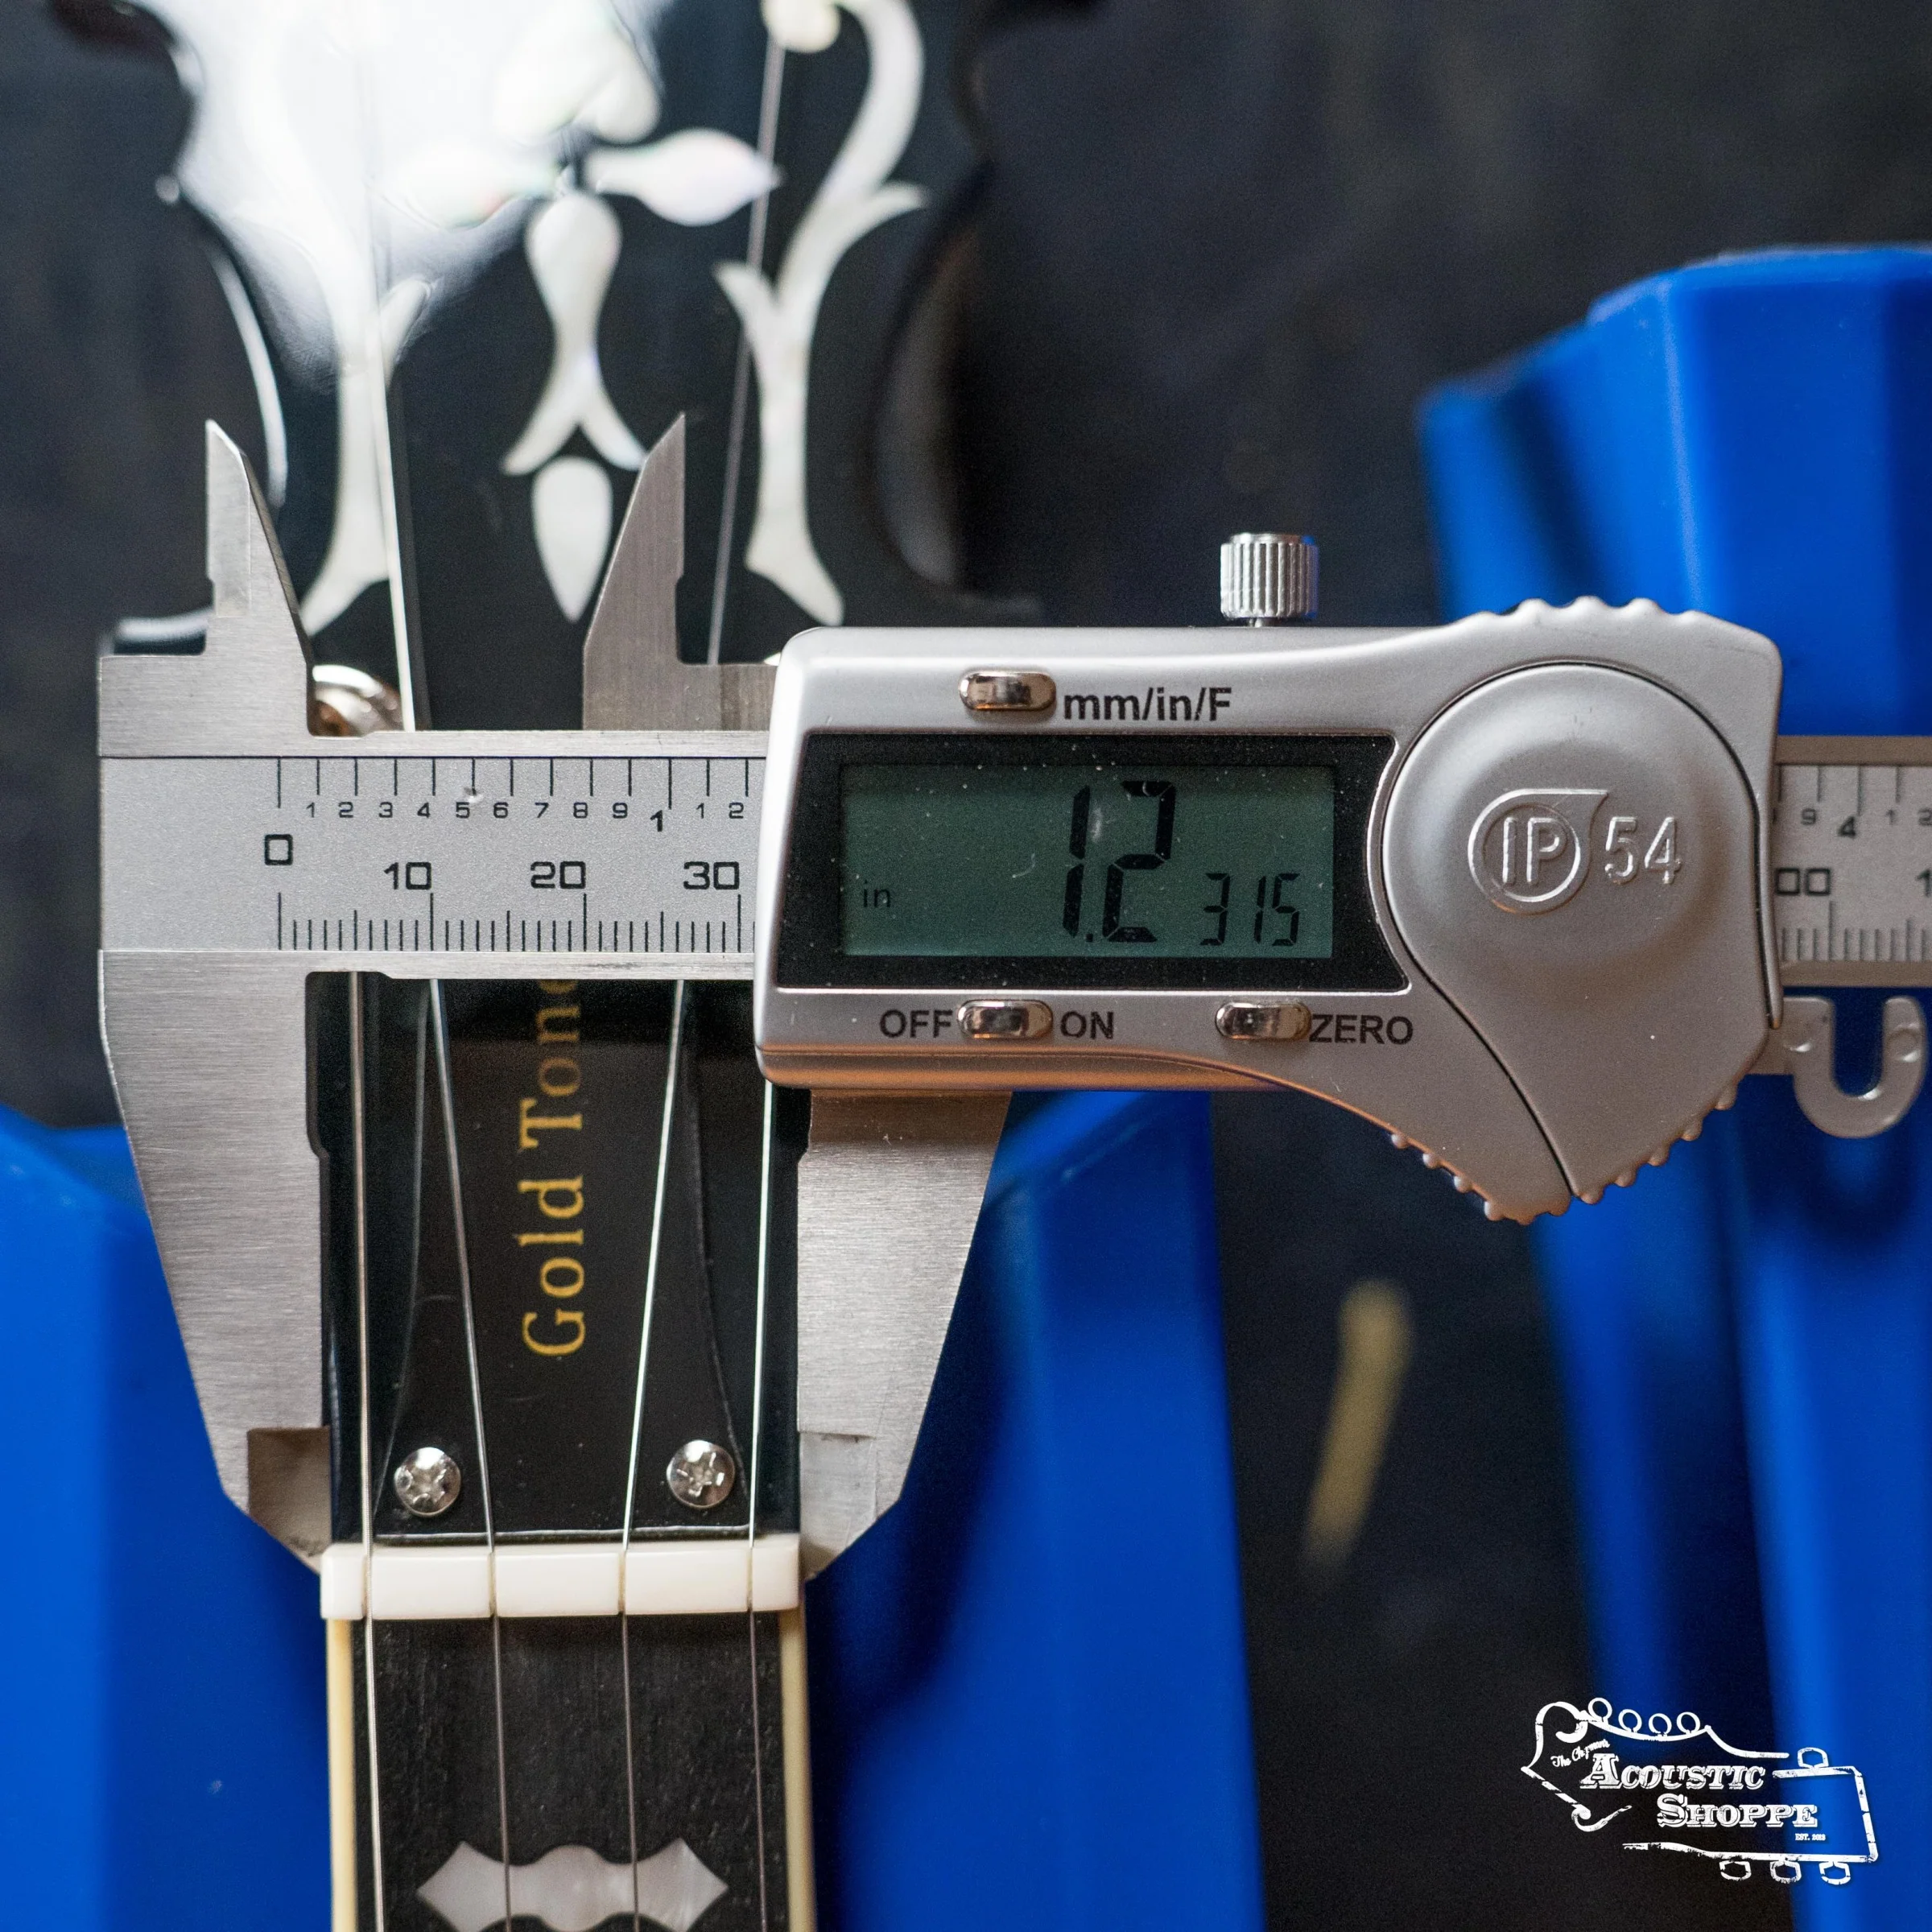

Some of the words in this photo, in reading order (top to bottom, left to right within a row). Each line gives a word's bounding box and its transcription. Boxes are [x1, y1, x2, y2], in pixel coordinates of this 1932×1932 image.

[1064, 687, 1232, 723] mm/in/F
[308, 802, 316, 819] 1
[339, 802, 354, 819] 2
[378, 802, 394, 819] 3
[417, 802, 431, 819] 4
[456, 802, 472, 820] 5
[493, 803, 510, 819] 6
[535, 803, 550, 819] 7
[572, 803, 589, 819] 8
[612, 803, 629, 820] 9
[650, 811, 664, 833] 1
[696, 803, 705, 819] 1
[729, 803, 745, 820] 2
[1801, 807, 1818, 826] 9
[1837, 815, 1857, 839] 4
[1886, 807, 1897, 826] 1
[1918, 807, 1932, 827] 2
[264, 834, 295, 867] 0
[1502, 815, 1570, 886] IP
[1604, 816, 1682, 886] 54
[383, 862, 433, 890] 10
[530, 861, 588, 890] 20
[683, 861, 741, 891] 30
[863, 879, 891, 908] in
[878, 1009, 955, 1039] OFF
[1059, 1010, 1115, 1042] ON
[1309, 1013, 1415, 1046] ZERO
[516, 1174, 587, 1357] Gold
